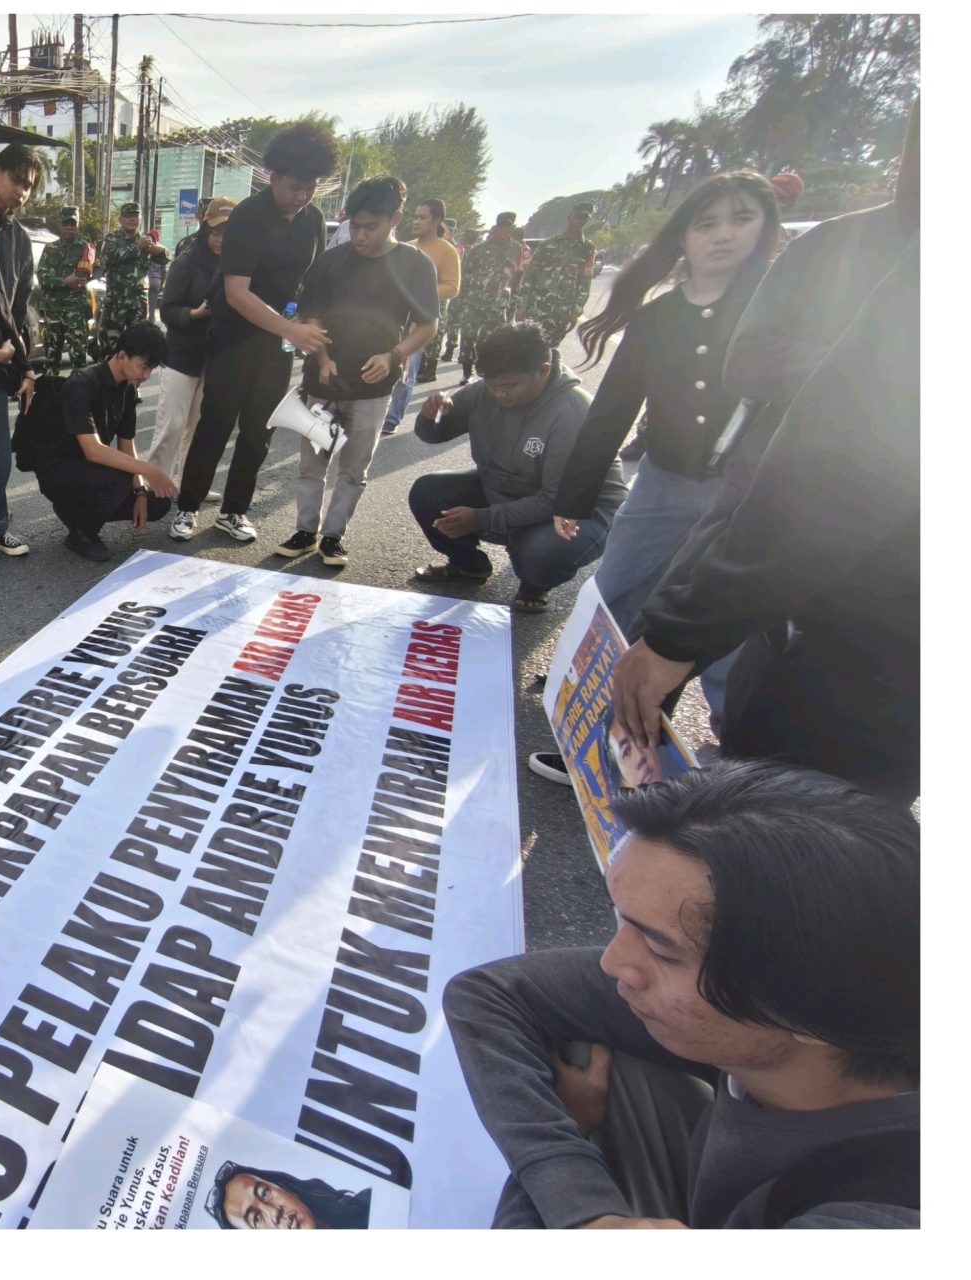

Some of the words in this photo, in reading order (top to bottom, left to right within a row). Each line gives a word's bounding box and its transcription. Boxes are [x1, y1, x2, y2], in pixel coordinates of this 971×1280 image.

[62, 601, 168, 669] YUNUS
[254, 591, 322, 644] KERAS
[76, 624, 208, 739] BERSUARA
[232, 641, 295, 682] AIR
[401, 620, 463, 685] KERAS
[392, 683, 456, 732] AIR
[110, 676, 276, 882] PENYIRAMAN
[180, 771, 307, 936] ANDRIE
[249, 683, 341, 773] YUNUS
[347, 726, 451, 941] MENYIRAM
[294, 927, 431, 1190] UNTUK
[99, 1175, 124, 1217] Suara
[118, 1136, 139, 1173] untuk
[120, 1166, 146, 1210] Yunus.
[147, 1145, 173, 1188] Kasus,
[160, 1135, 191, 1202] Keadilan!
[174, 1191, 195, 1229] kpapan
[187, 1145, 209, 1190] Bersuara
